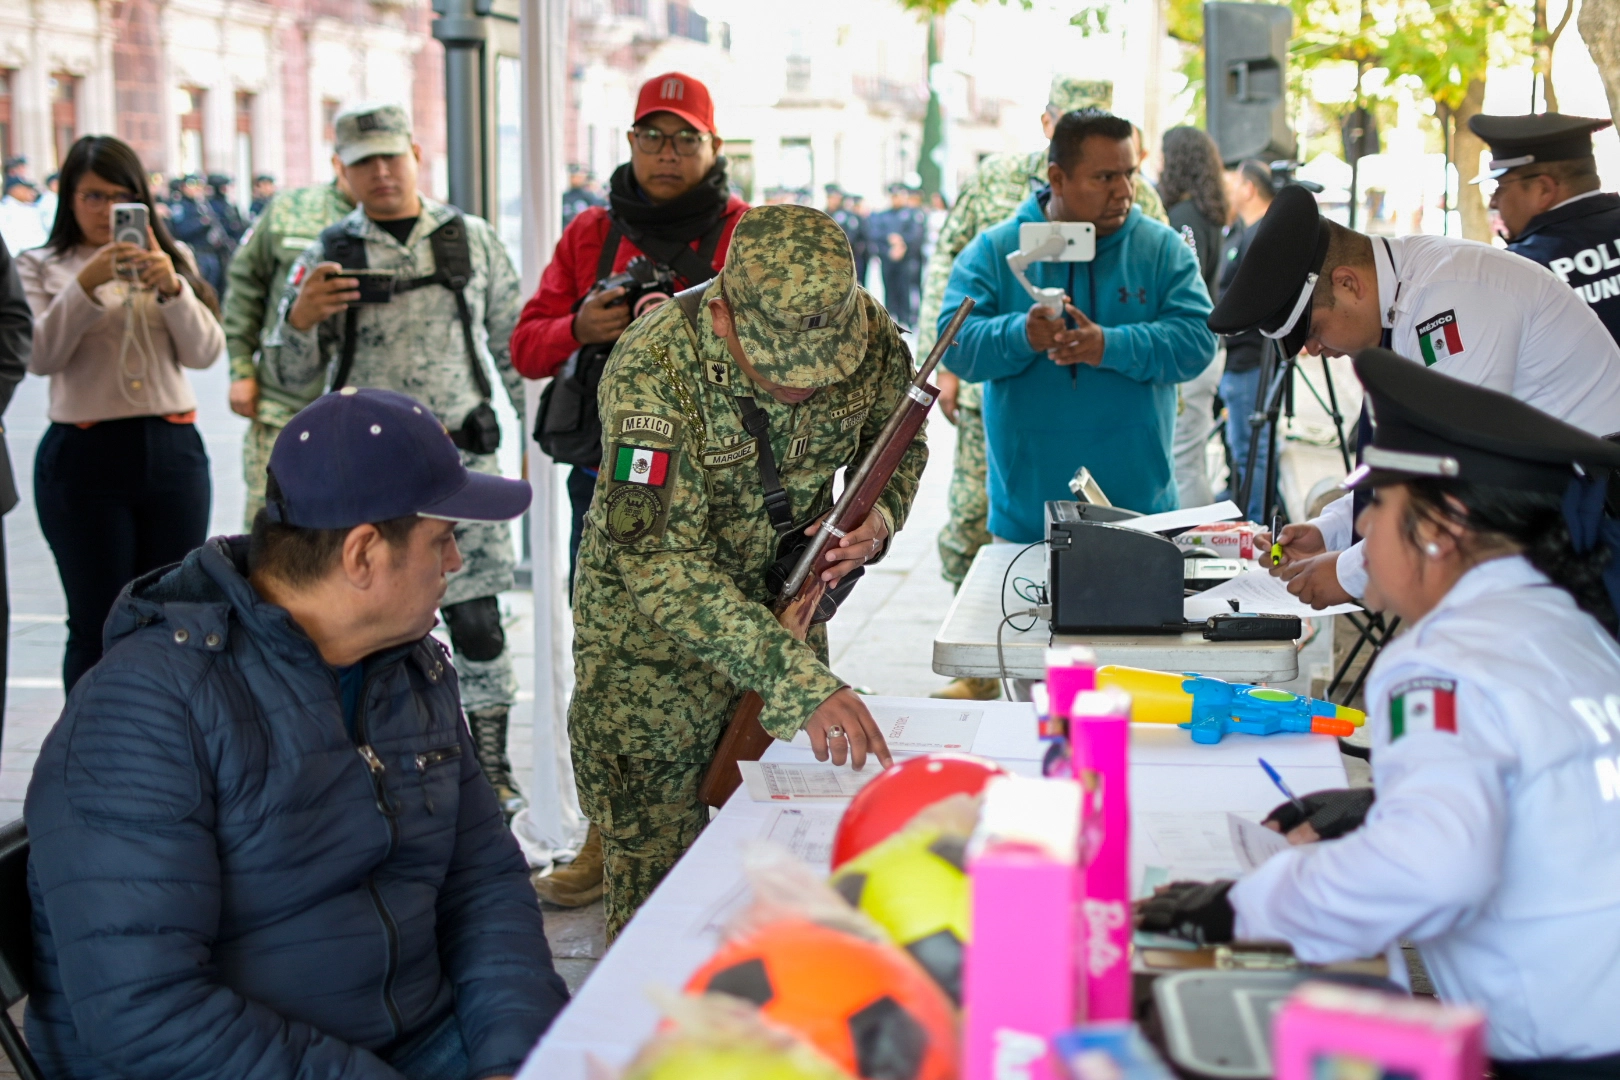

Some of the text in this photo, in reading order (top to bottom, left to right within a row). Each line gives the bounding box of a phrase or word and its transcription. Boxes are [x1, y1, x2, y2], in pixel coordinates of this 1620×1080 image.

[1548, 239, 1620, 283] POL
[1574, 273, 1620, 304] UN
[1419, 314, 1453, 335] MÉXICO
[625, 417, 670, 436] MEXICO
[712, 445, 752, 464] MARQUEZ
